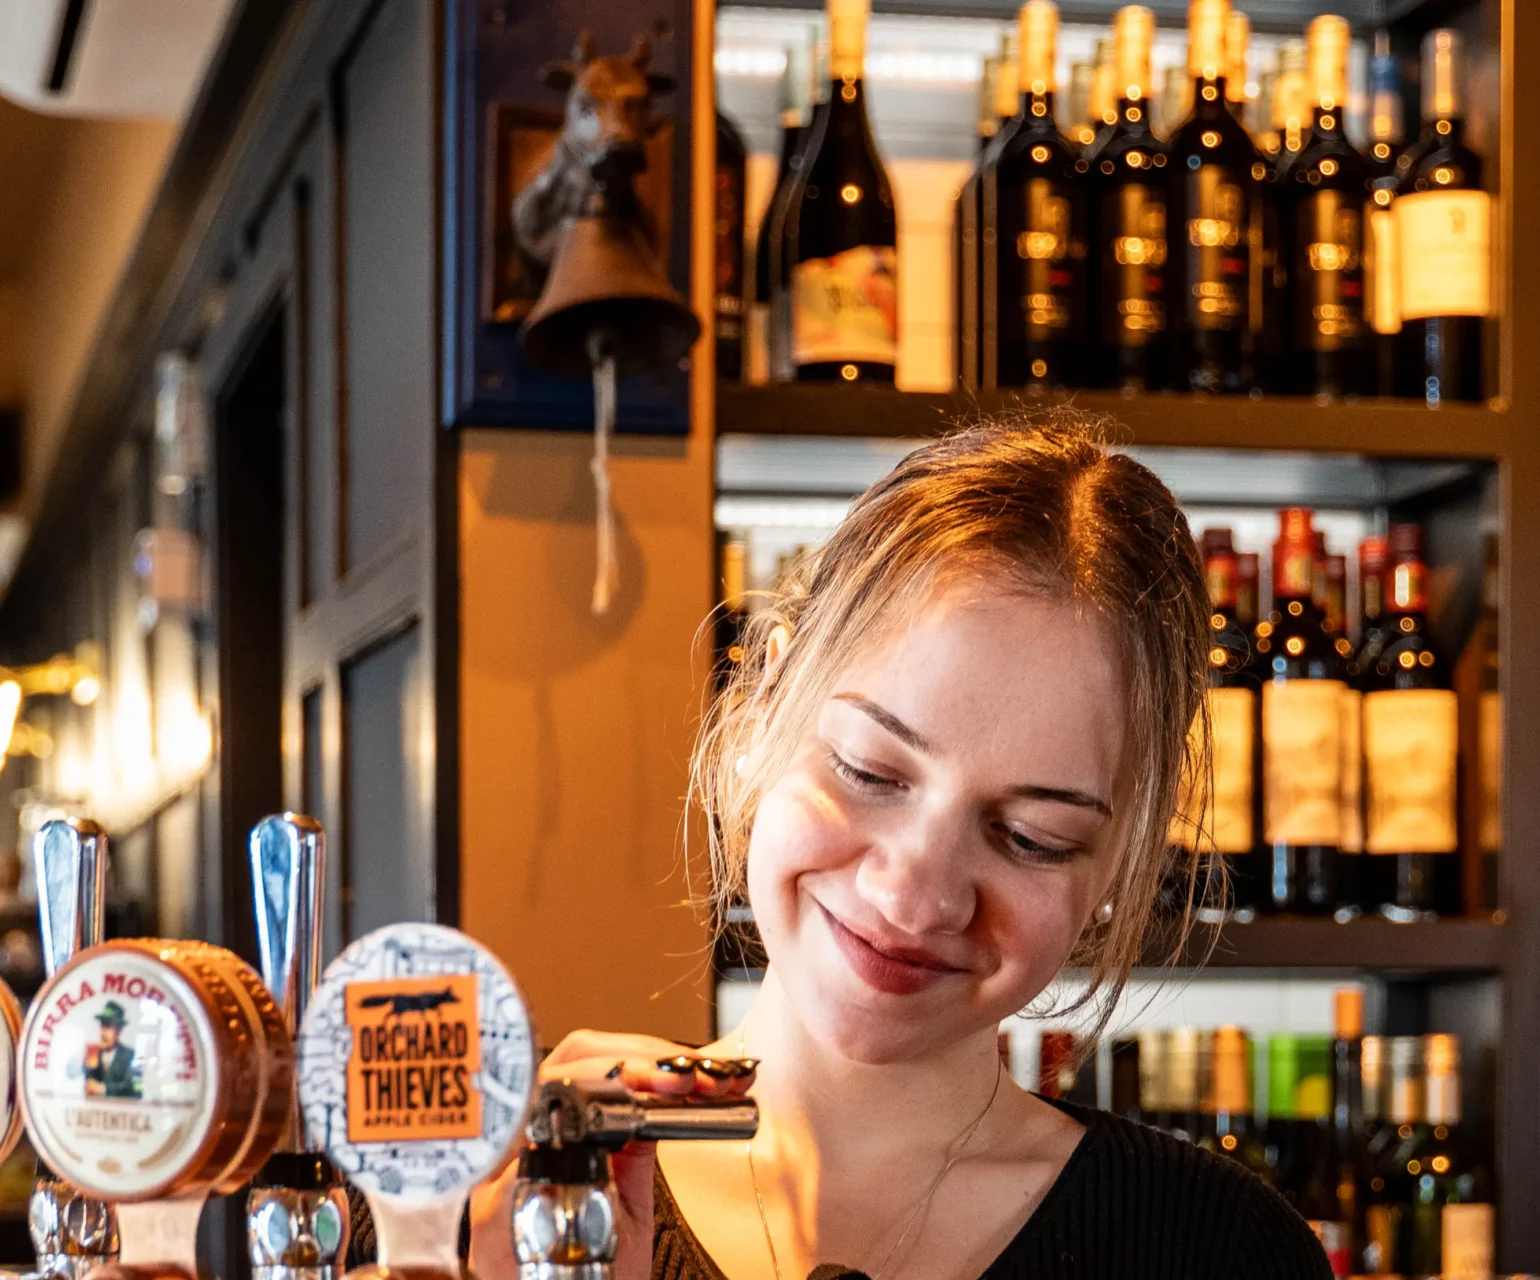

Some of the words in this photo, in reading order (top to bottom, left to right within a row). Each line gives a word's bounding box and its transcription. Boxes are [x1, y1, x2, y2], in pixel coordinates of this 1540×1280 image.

[34, 980, 95, 1070] BIRRA
[360, 1021, 468, 1064] ORCHARD
[361, 1064, 469, 1111] THIEVES
[363, 1114, 412, 1128] APPLE
[418, 1112, 468, 1126] CIDER
